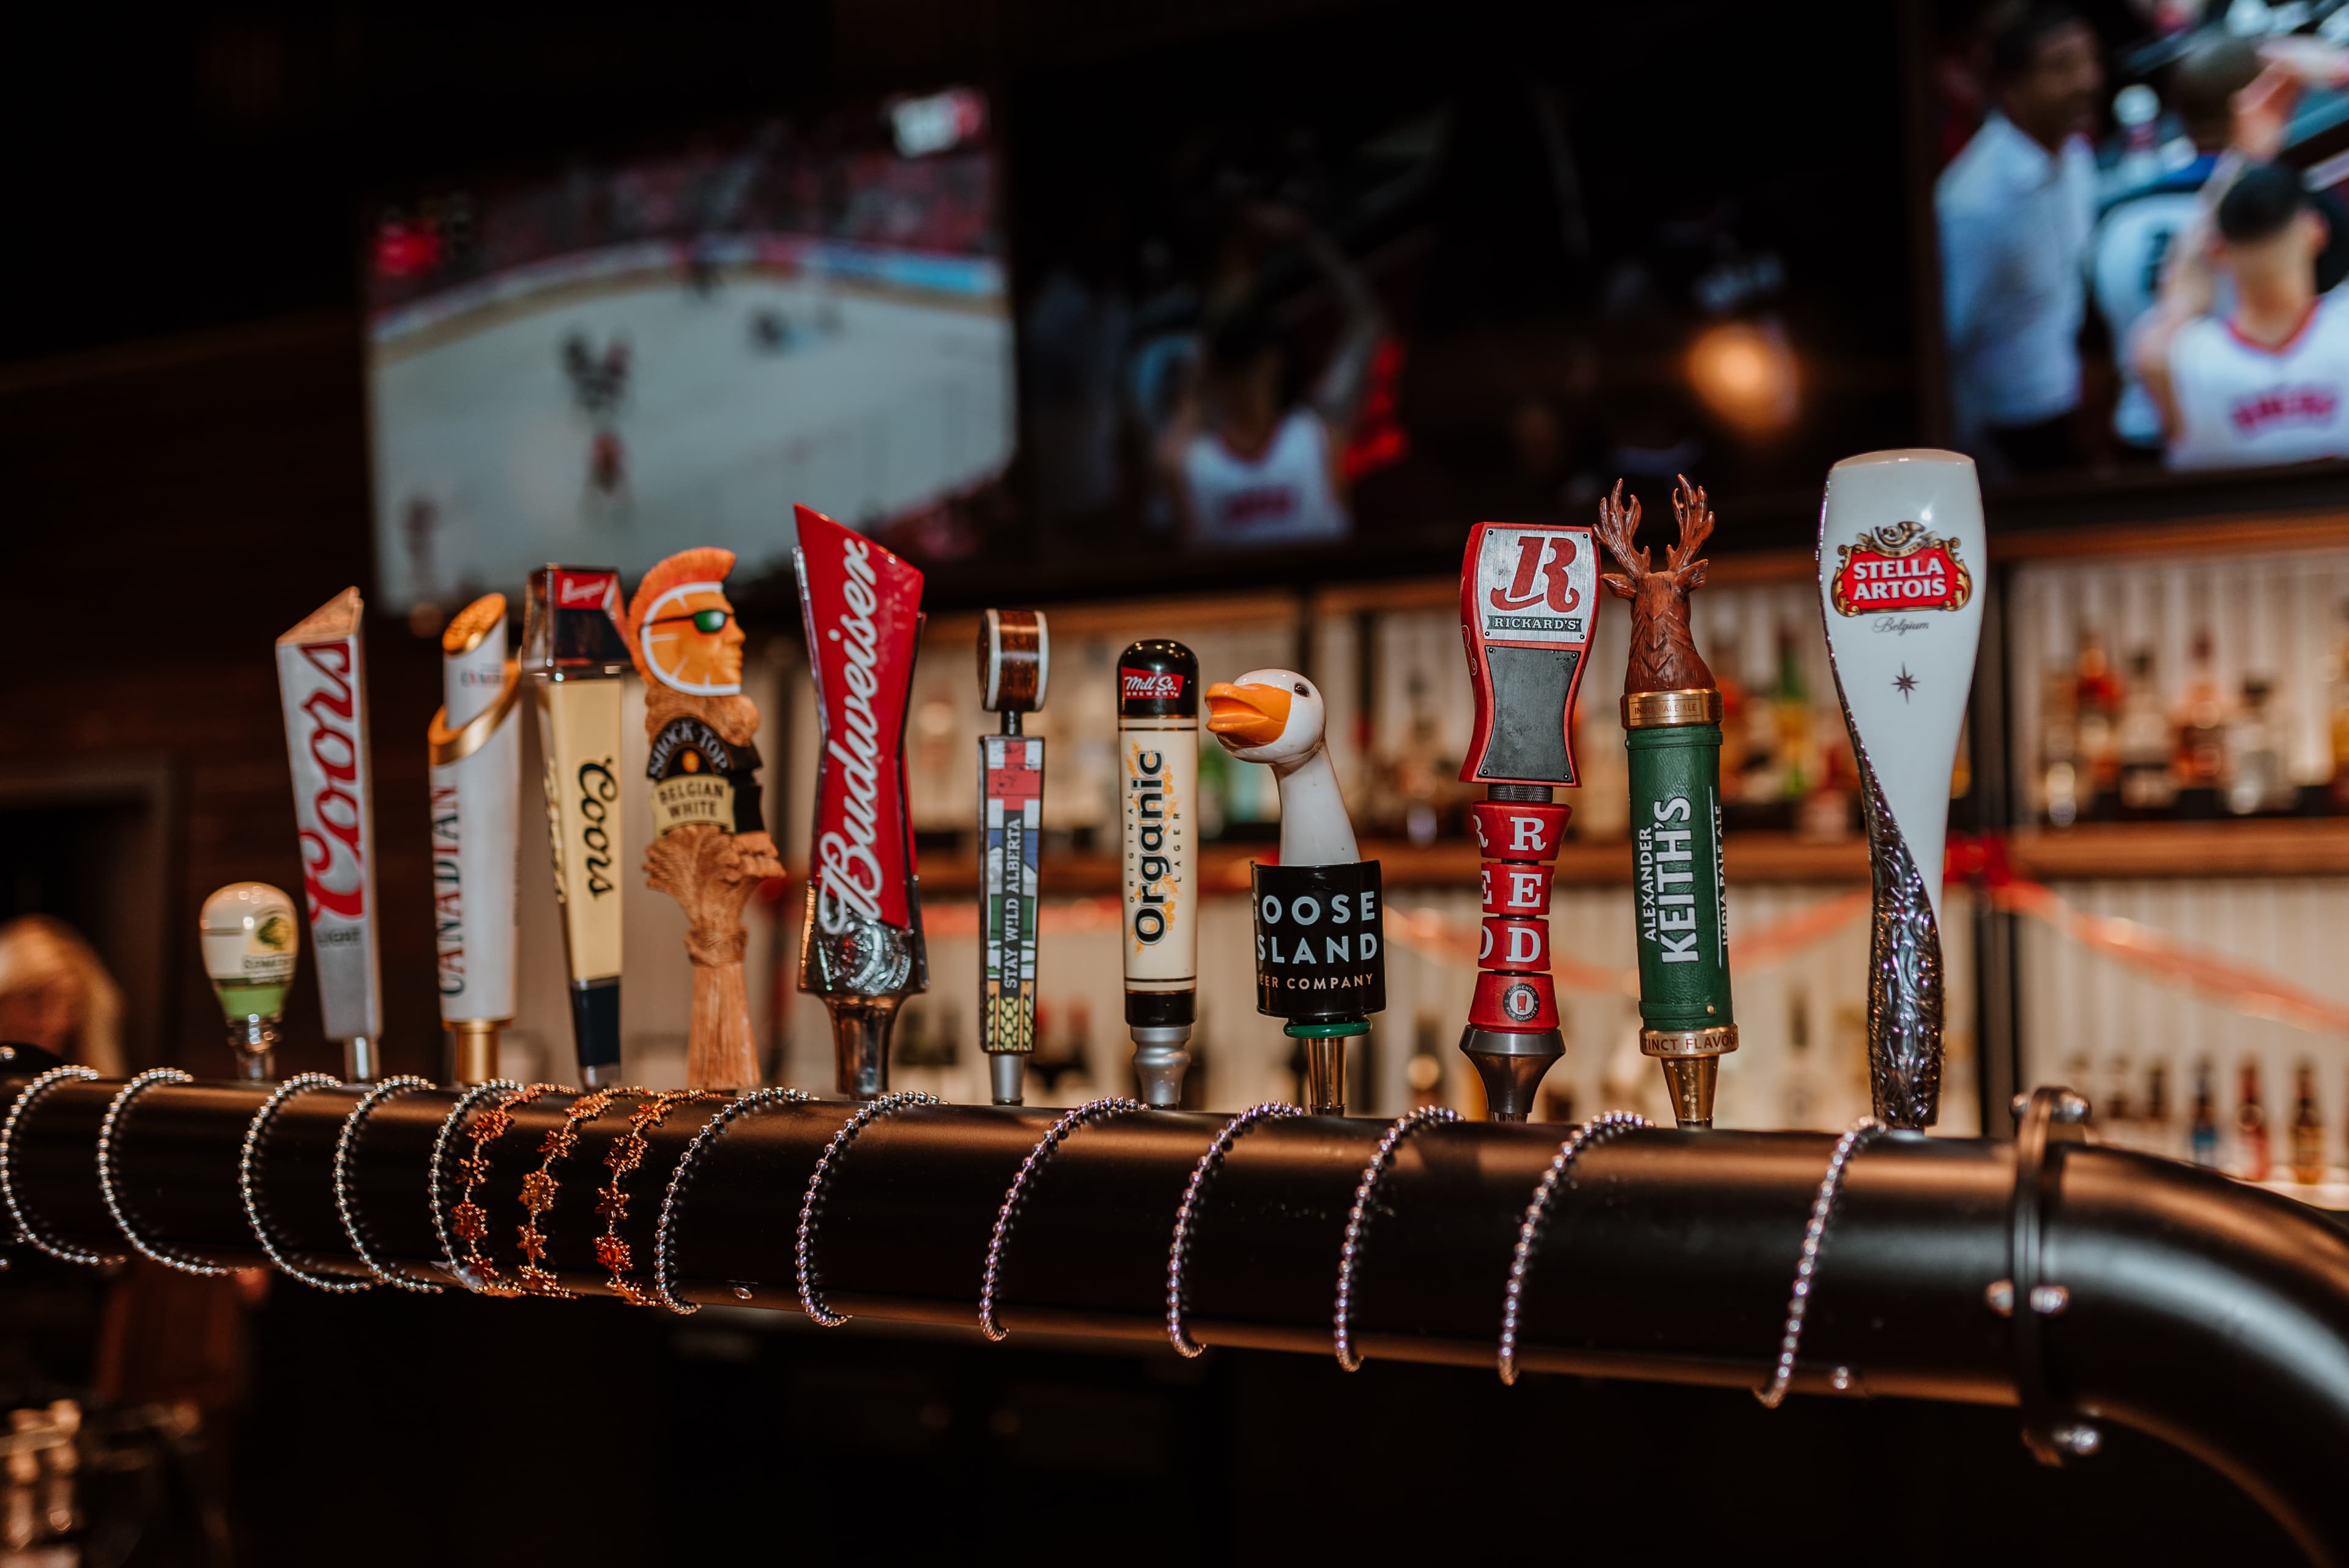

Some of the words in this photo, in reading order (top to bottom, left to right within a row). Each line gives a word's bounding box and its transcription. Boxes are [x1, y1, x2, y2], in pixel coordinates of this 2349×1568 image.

[1490, 536, 1580, 613] R
[1853, 557, 1945, 580] STELLA
[1853, 578, 1947, 601] ARTOIS
[1494, 617, 1578, 631] RICKARD'S
[1872, 615, 1929, 637] Belgium
[1124, 675, 1156, 690] Mill
[1156, 675, 1177, 691] St.
[1635, 706, 1655, 715] INDIA
[1658, 704, 1679, 713] PALE
[1683, 703, 1697, 712] ALE
[648, 720, 694, 778] SHOCK
[699, 725, 729, 772] TOP
[818, 537, 885, 935] Budweiser
[299, 639, 364, 921] Coors
[658, 781, 725, 805] BELGIAN
[668, 801, 716, 817] WHITE
[578, 756, 618, 901] Coors
[1006, 818, 1021, 893] ALBERTA
[1132, 750, 1172, 945] Organic
[1173, 812, 1182, 882] LAGER
[430, 783, 466, 999] CANADIAN
[1639, 826, 1658, 942] ALEXANDER
[1652, 796, 1700, 964] KEITH'S
[1257, 933, 1378, 964] SLAND
[1004, 947, 1018, 989] STAY
[1257, 974, 1279, 988] EER
[1286, 973, 1373, 989] COMPANY
[1507, 985, 1537, 997] AUTHENTIC
[1506, 1007, 1516, 1018] PUB
[1517, 1007, 1538, 1021] QUALITY
[1641, 1037, 1678, 1051] TINCT
